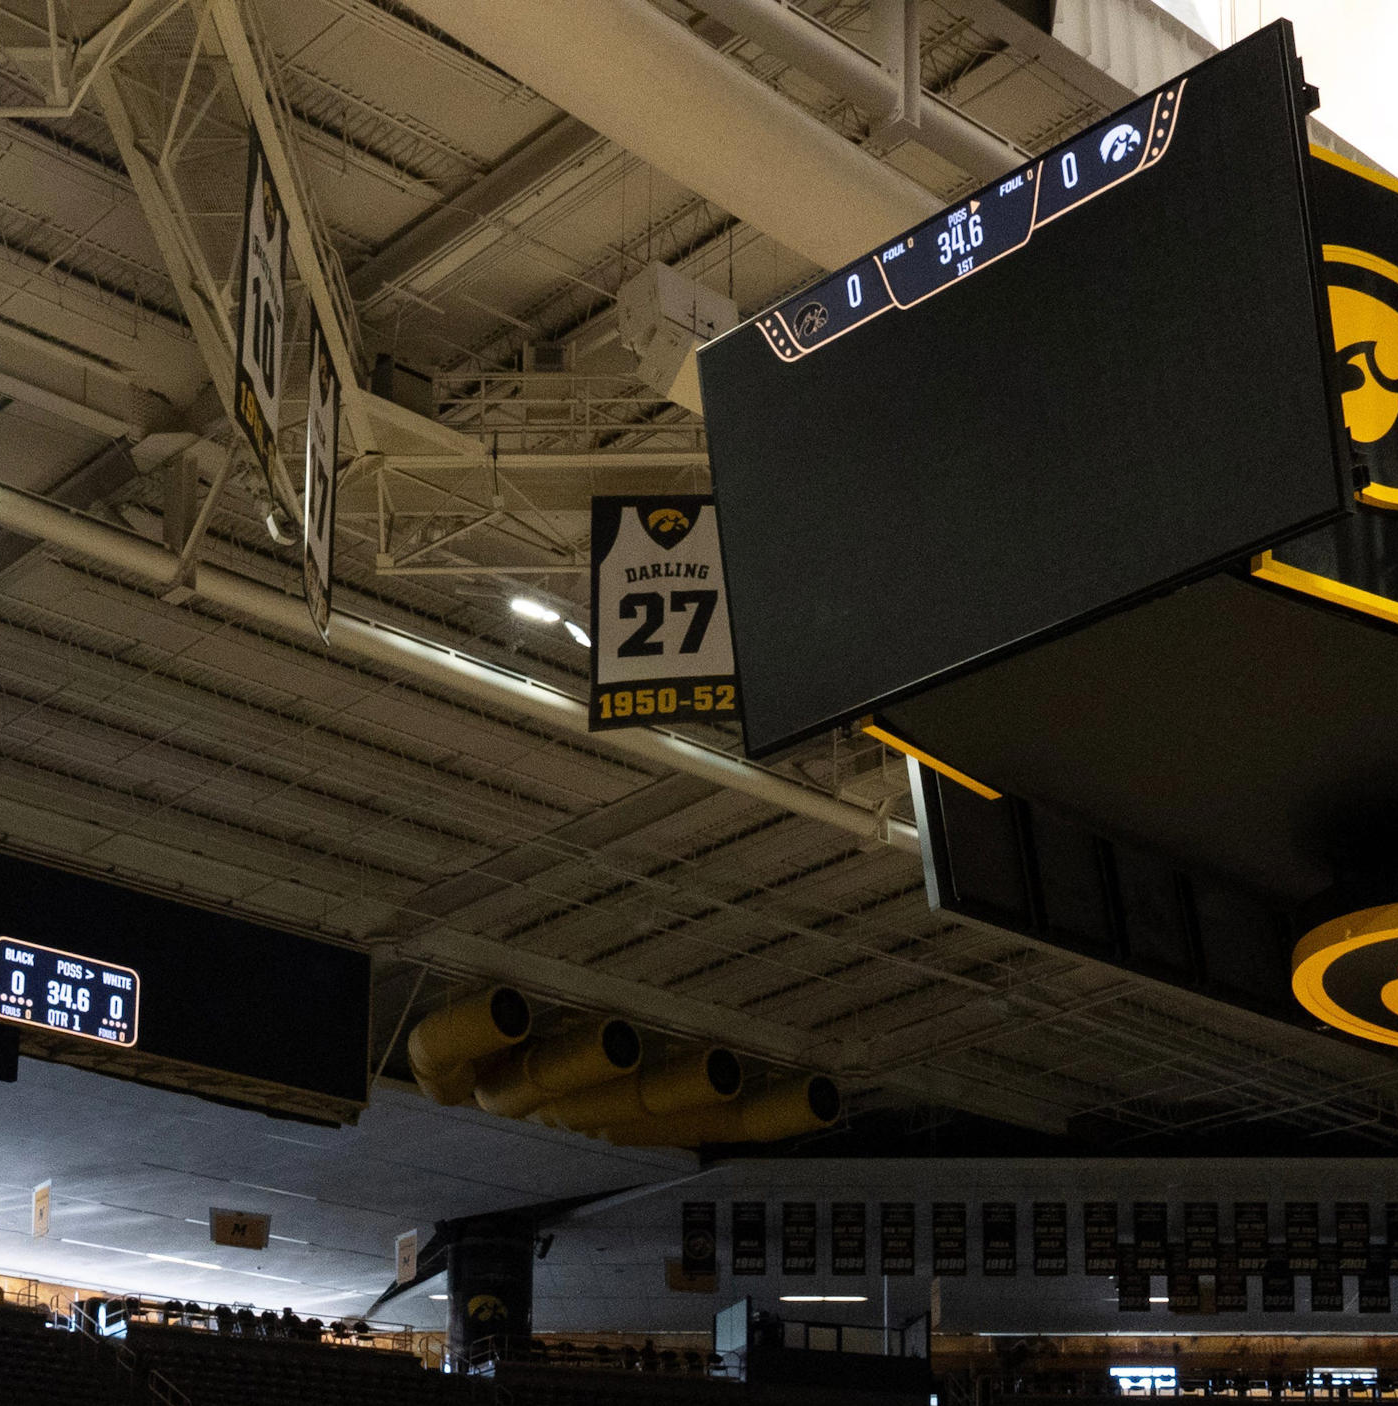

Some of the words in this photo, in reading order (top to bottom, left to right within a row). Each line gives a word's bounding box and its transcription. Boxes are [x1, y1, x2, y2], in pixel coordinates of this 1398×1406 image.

[1061, 151, 1078, 190] 0
[999, 173, 1025, 196] FOUL
[947, 208, 968, 227] POSS
[937, 215, 983, 266] 34.6
[882, 243, 906, 263] FOUL
[956, 257, 975, 276] 1ST
[846, 273, 863, 308] 0
[624, 562, 710, 584] DARLING
[617, 589, 719, 658] 27
[599, 684, 736, 719] 1950-52
[5, 948, 35, 967] BLACK
[57, 960, 82, 979] POSS
[11, 970, 25, 995] 0
[102, 972, 132, 990] WHITE
[47, 980, 90, 1012] 34.6
[109, 995, 123, 1019] 0
[2, 1005, 21, 1017] FOULS
[48, 1009, 68, 1027] QTR
[73, 1014, 81, 1031] 1
[230, 1223, 247, 1237] M
